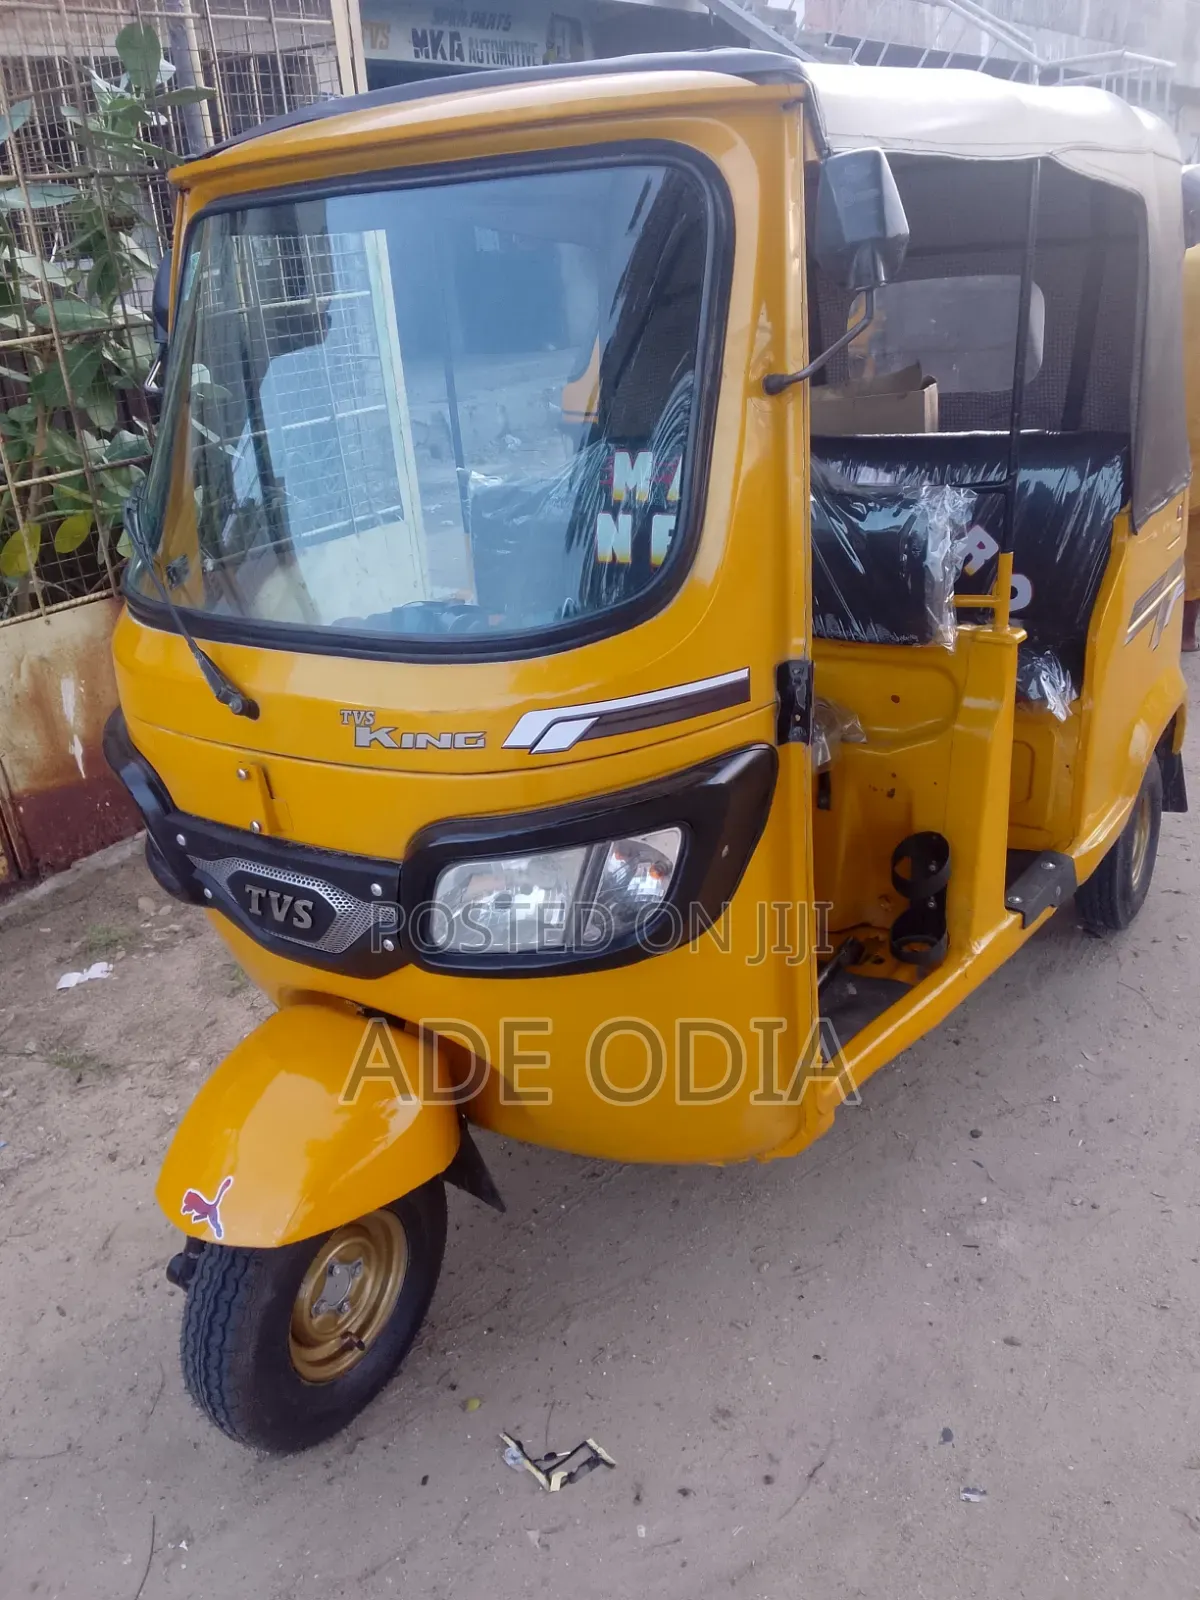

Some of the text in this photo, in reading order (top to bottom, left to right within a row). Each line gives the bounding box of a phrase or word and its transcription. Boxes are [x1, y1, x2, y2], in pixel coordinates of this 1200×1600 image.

[411, 28, 539, 67] MKA AUTOMOTIVE
[340, 709, 375, 725] TVS
[244, 884, 314, 929] TVS
